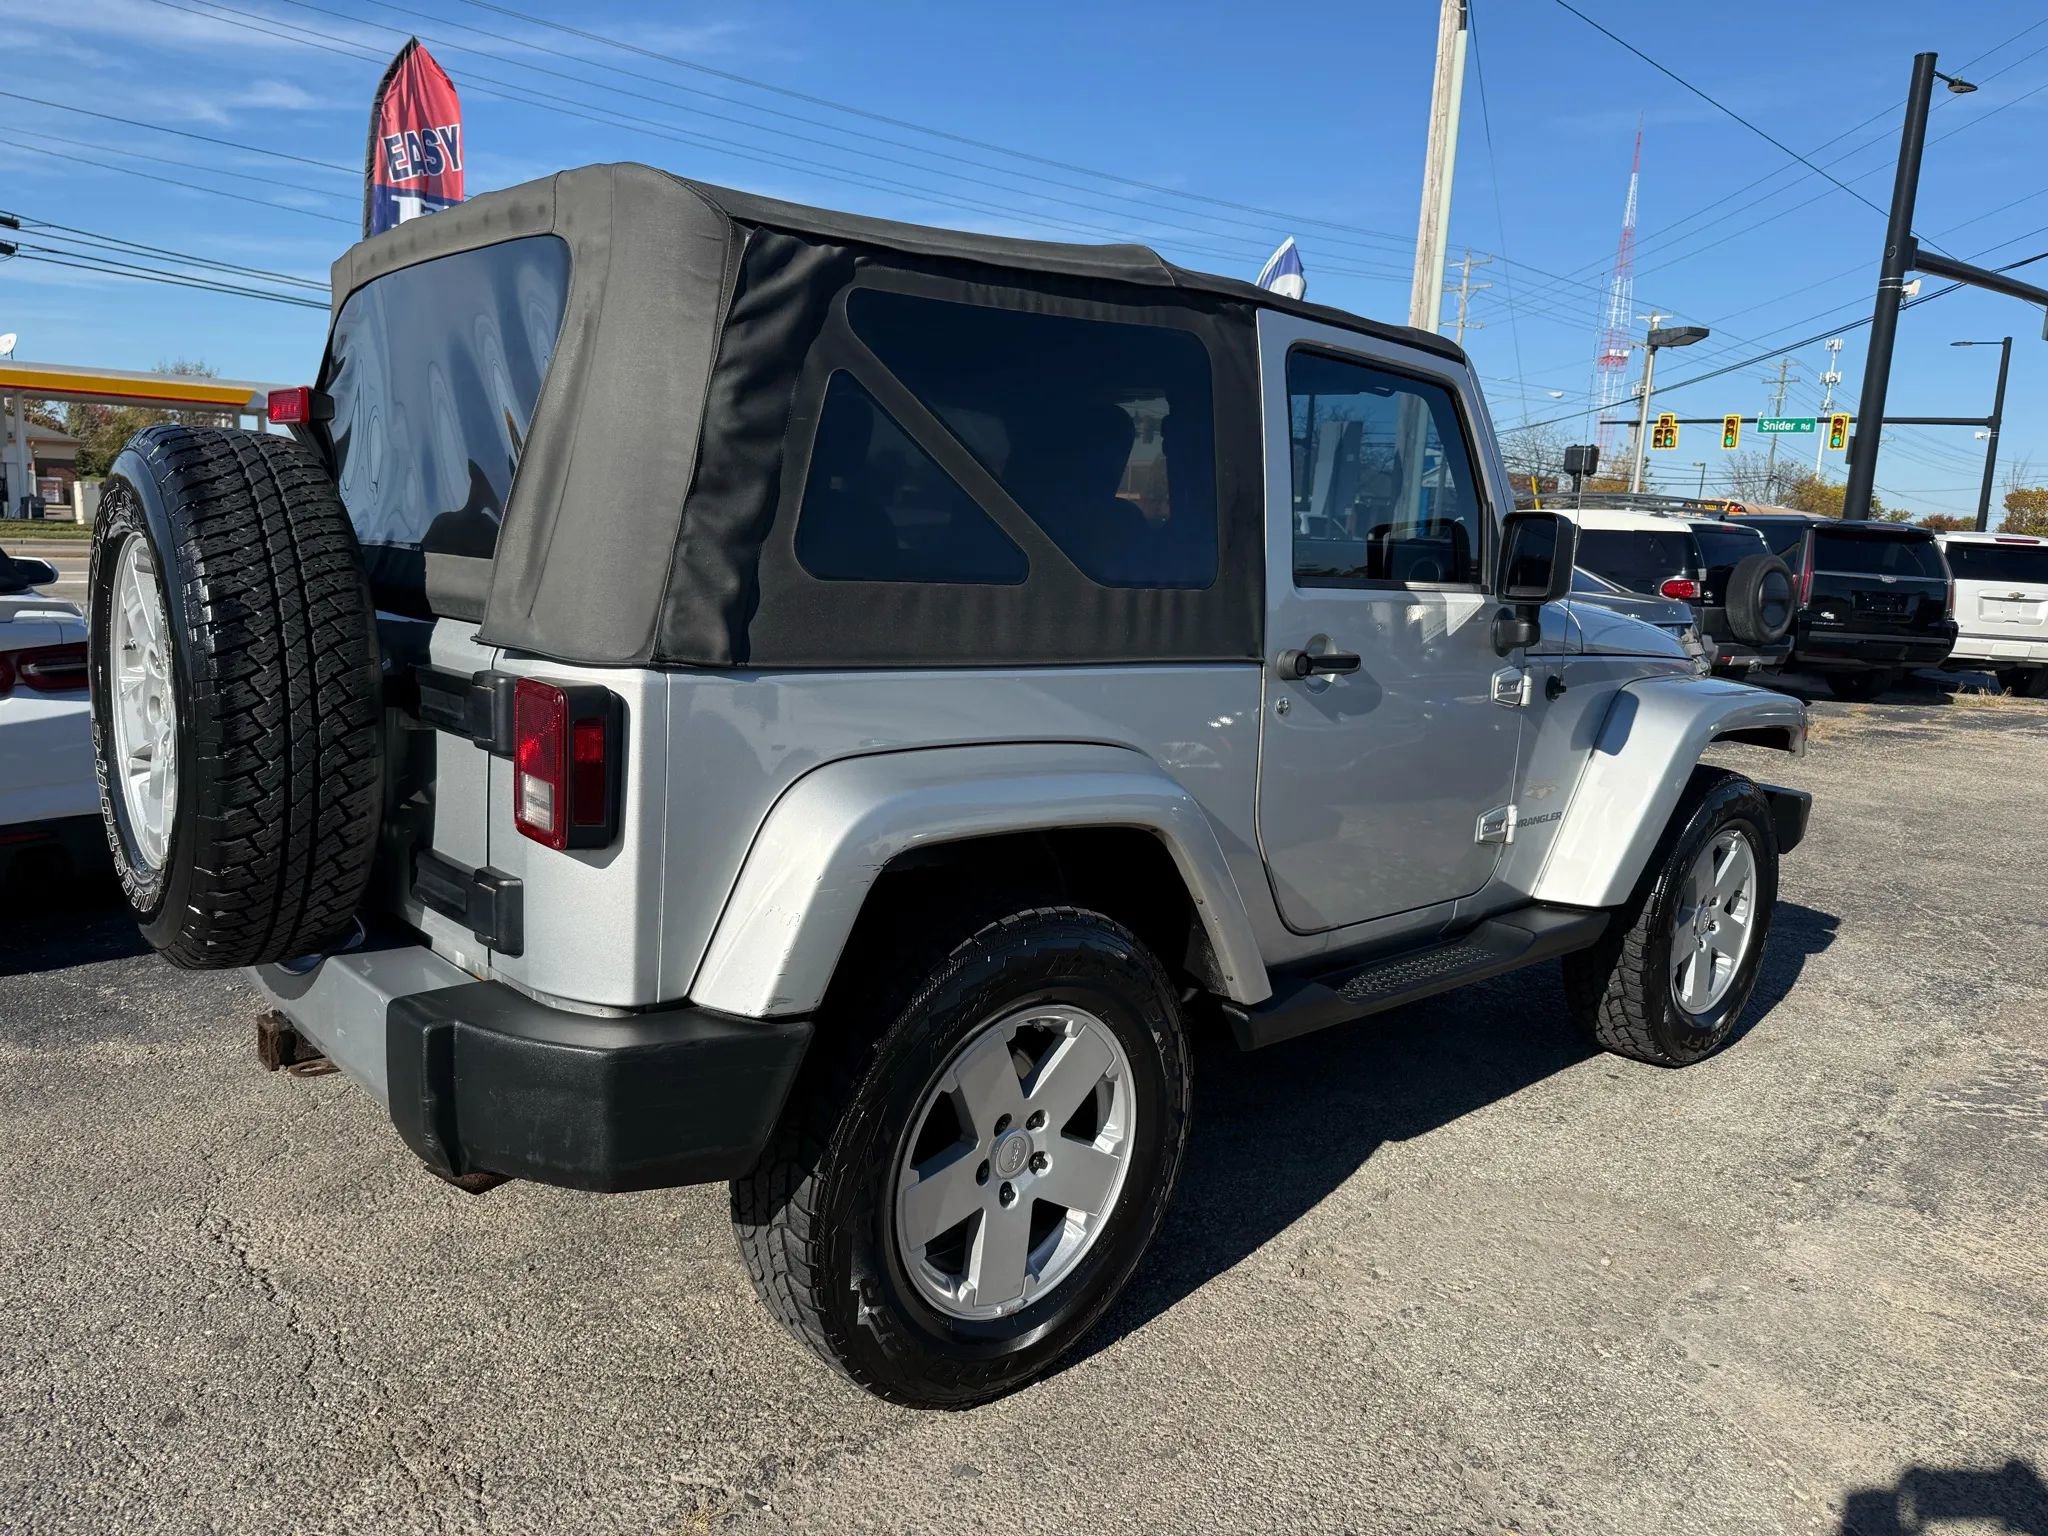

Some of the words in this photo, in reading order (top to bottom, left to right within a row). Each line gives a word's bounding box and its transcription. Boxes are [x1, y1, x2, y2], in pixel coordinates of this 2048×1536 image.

[382, 124, 463, 183] EASY
[1762, 420, 1796, 431] Snider
[1800, 423, 1811, 431] Rd
